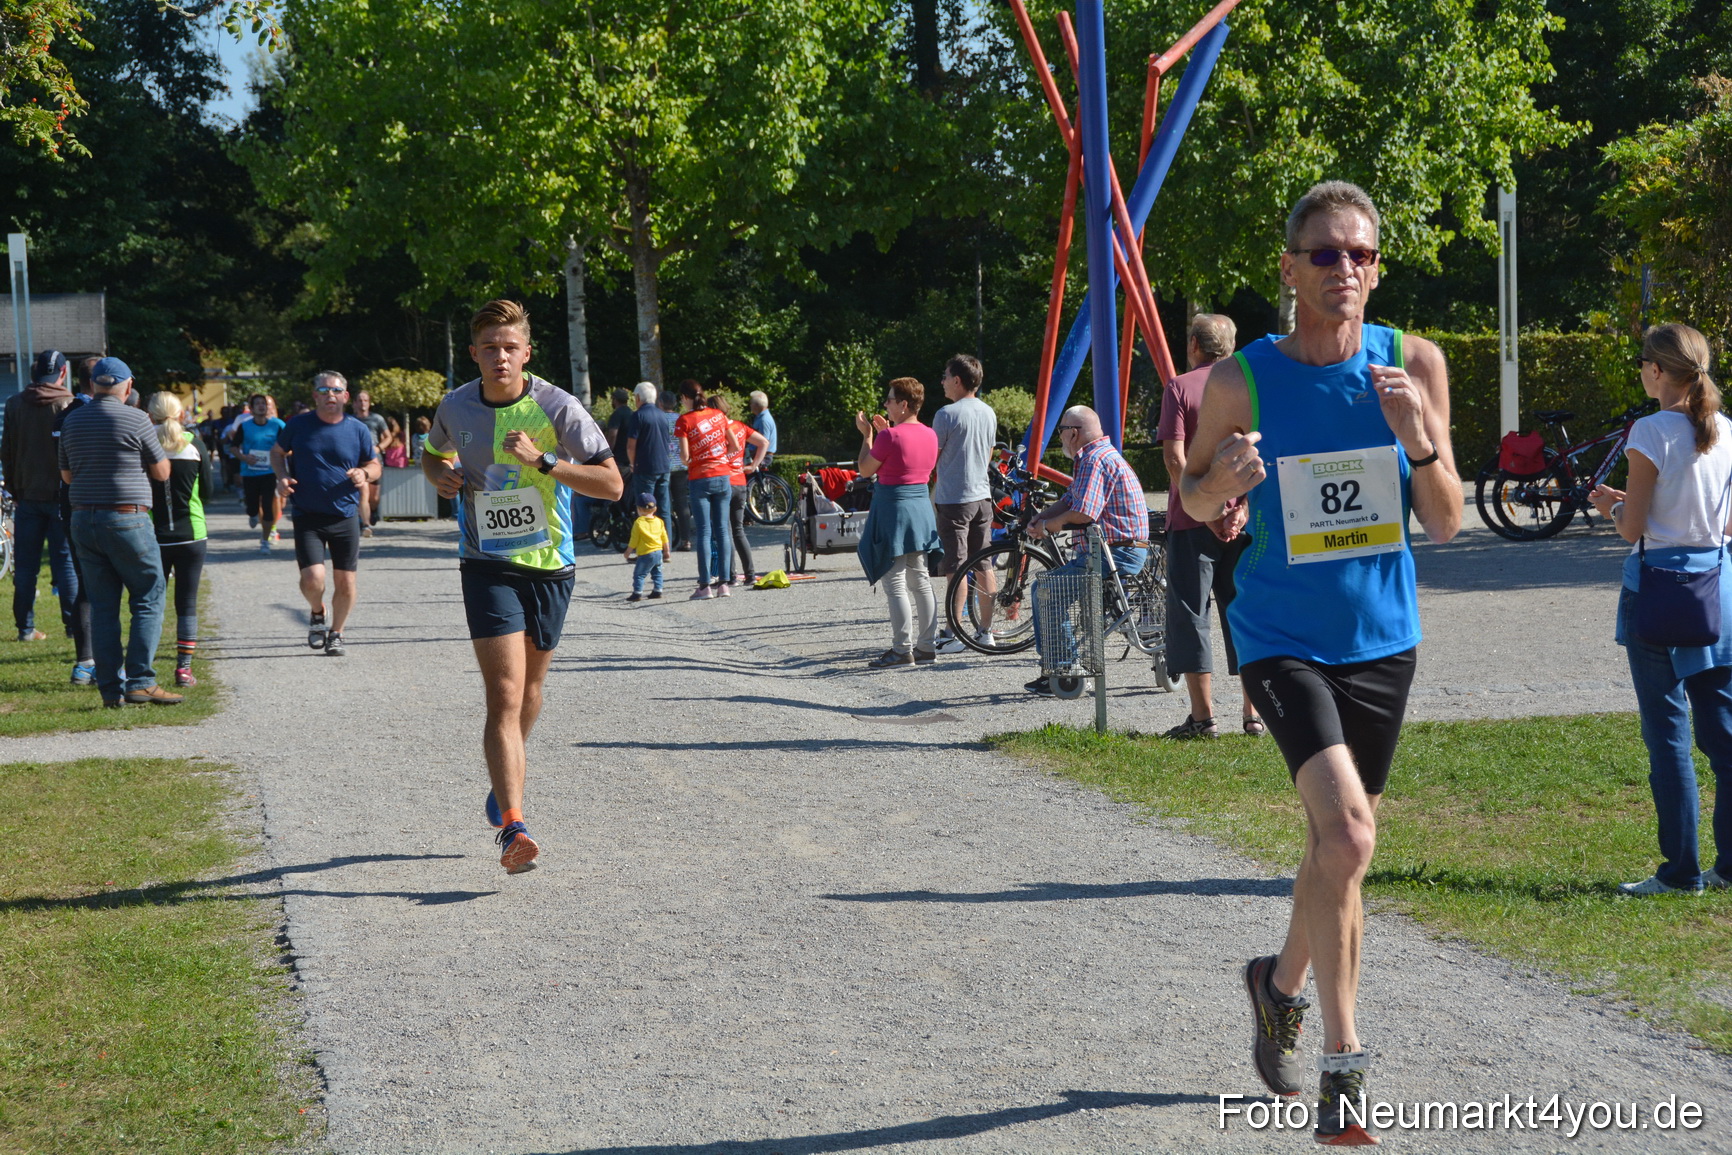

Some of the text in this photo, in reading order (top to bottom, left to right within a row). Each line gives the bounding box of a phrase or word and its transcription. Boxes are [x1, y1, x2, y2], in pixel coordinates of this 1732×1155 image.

[1313, 459, 1364, 475] BOCK
[490, 494, 520, 504] BOCK
[1320, 480, 1363, 515] 82
[485, 505, 536, 530] 3083
[1310, 516, 1368, 529] PARTL Neumarkt
[495, 539, 528, 548] Lucas
[1323, 531, 1368, 549] Martin
